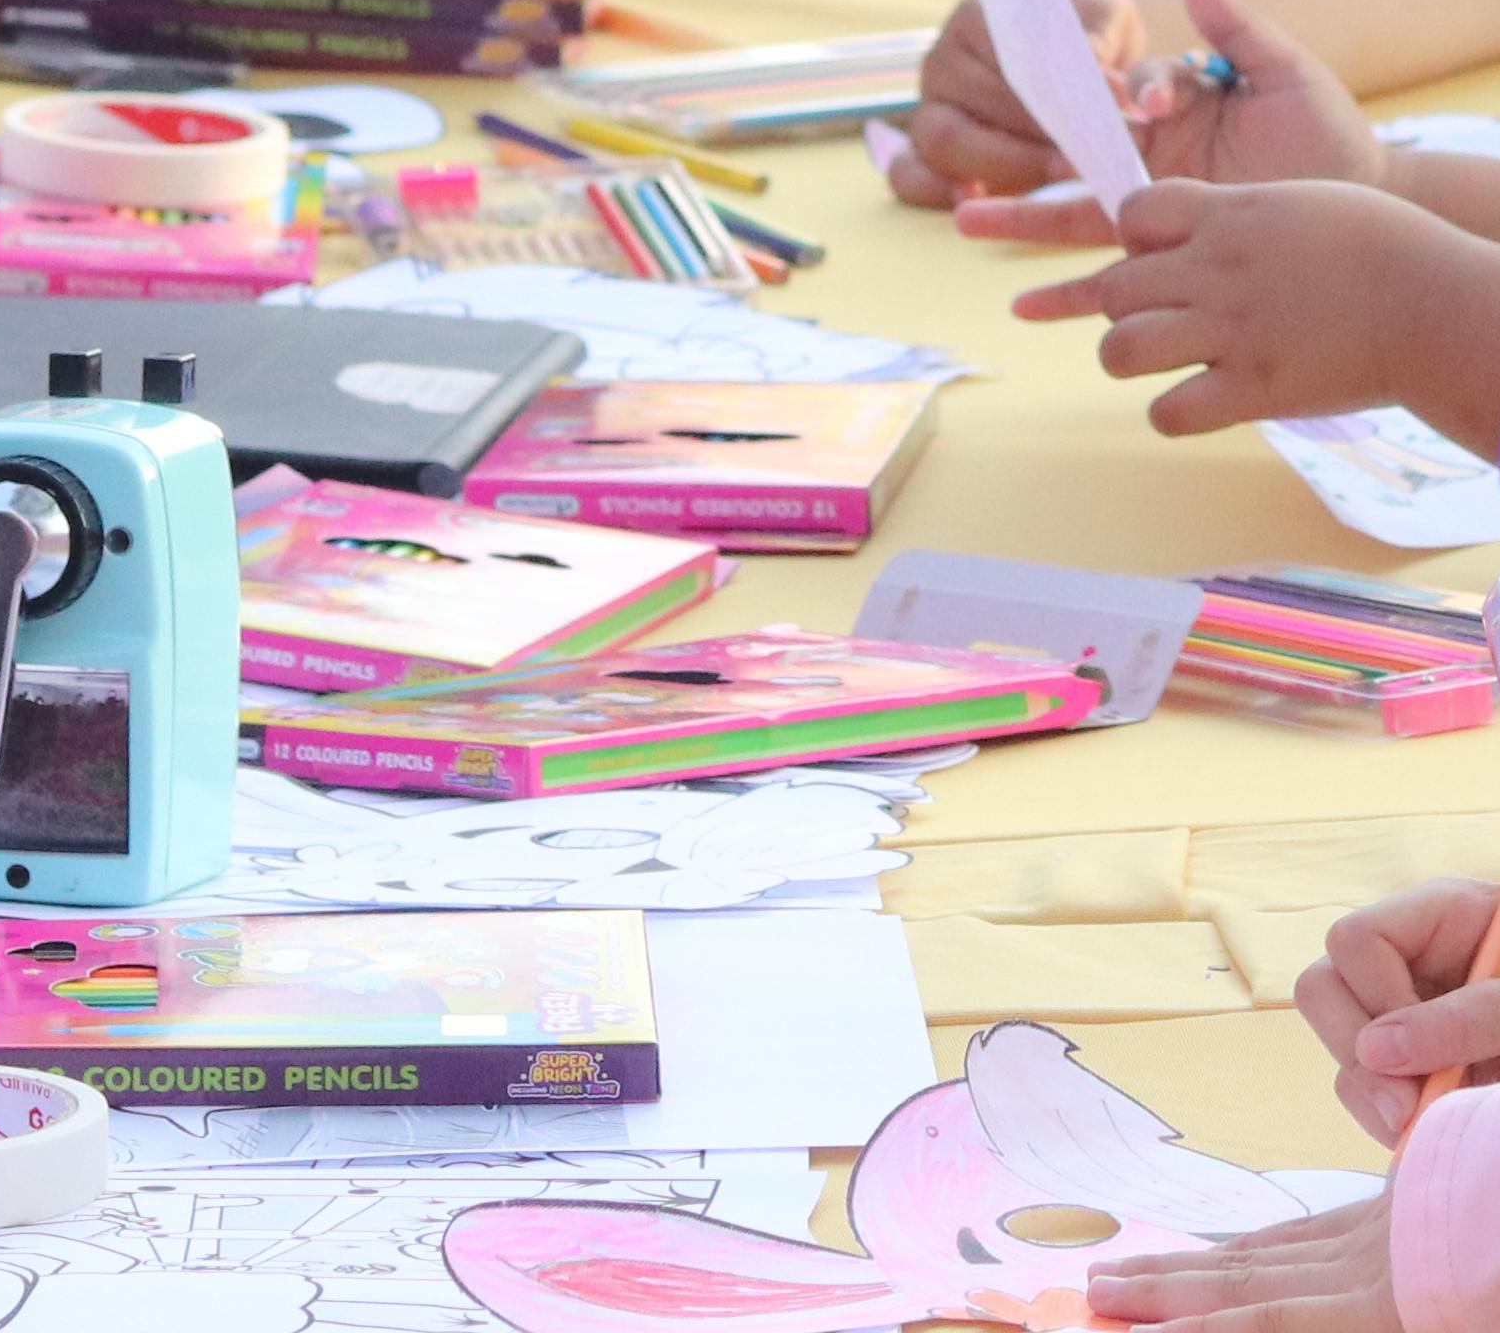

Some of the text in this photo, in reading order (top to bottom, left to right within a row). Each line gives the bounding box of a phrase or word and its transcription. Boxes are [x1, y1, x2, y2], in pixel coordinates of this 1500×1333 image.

[302, 655, 377, 682] PENCILS
[273, 743, 292, 760] 12
[296, 745, 371, 767] COLOURED
[376, 751, 435, 773] PENCILS
[539, 1054, 590, 1068] SUPER
[83, 1066, 266, 1093] COLOURED
[284, 1065, 419, 1091] PENCILS
[531, 1066, 596, 1083] BRIGHT
[549, 1084, 583, 1095] NEON
[586, 1083, 617, 1095] TONE
